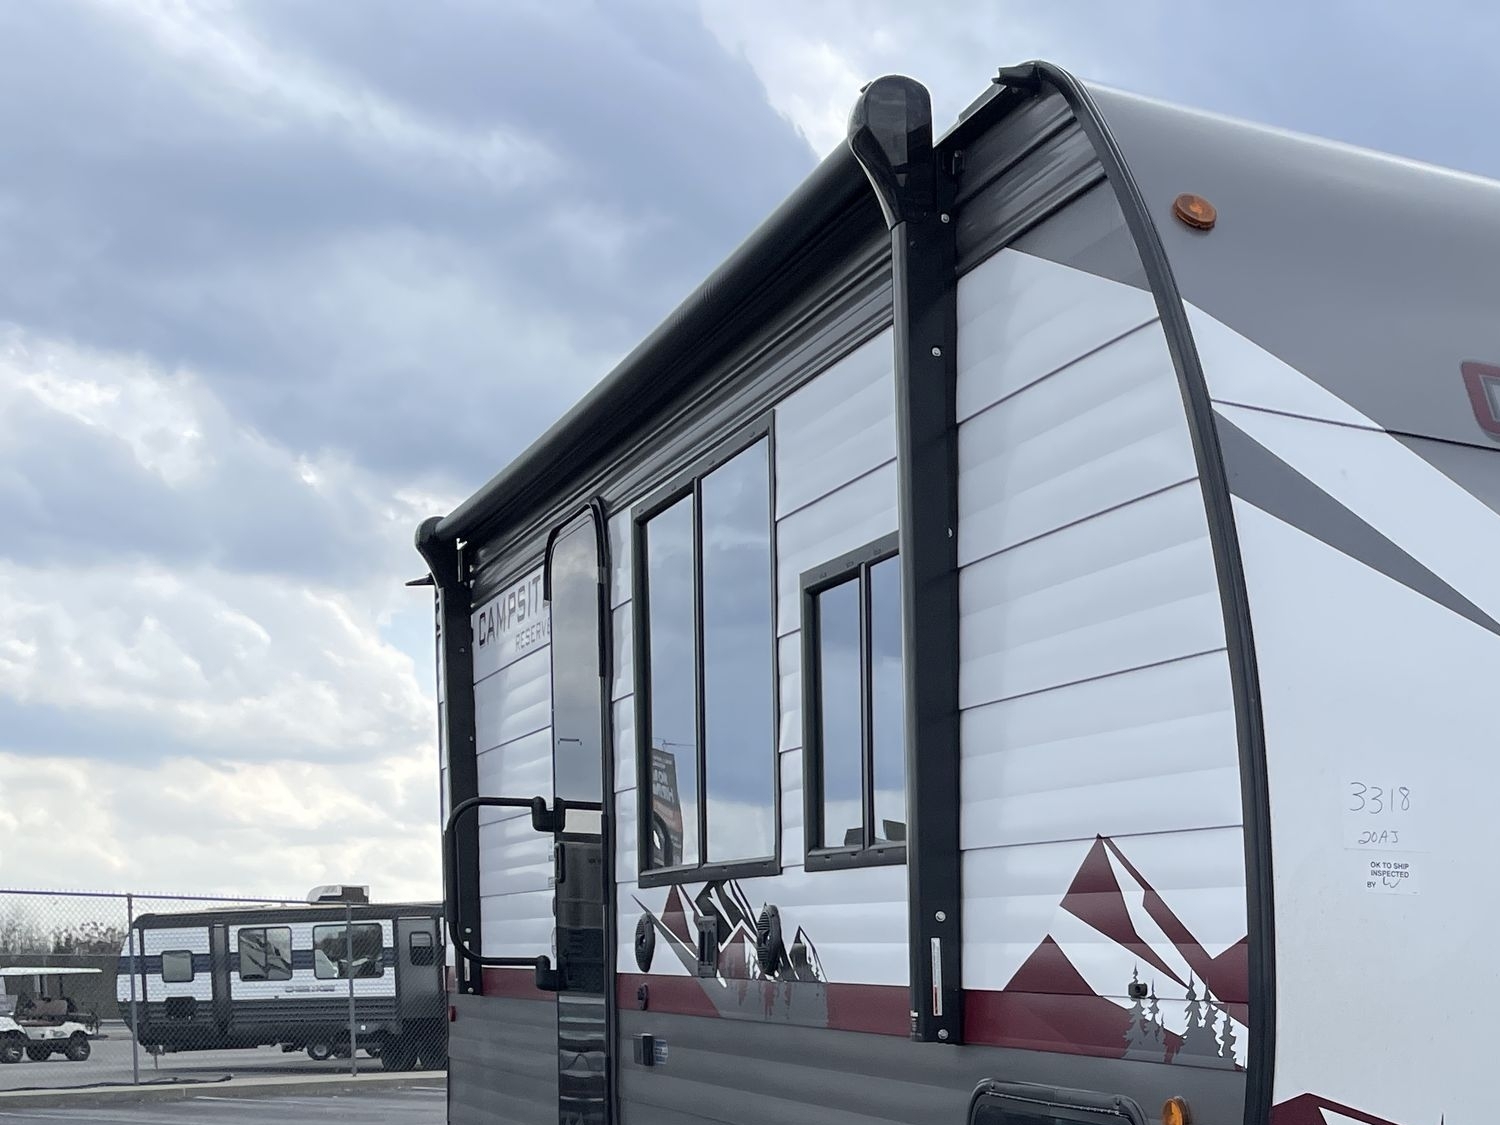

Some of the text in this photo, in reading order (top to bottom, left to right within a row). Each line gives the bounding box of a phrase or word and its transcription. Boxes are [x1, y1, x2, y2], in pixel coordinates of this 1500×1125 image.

[478, 574, 550, 648] CAMPSIT
[1348, 781, 1410, 815] 3318
[1370, 861, 1381, 869] OK
[1393, 862, 1410, 870] SHIP
[1370, 869, 1410, 878] INSPECTED
